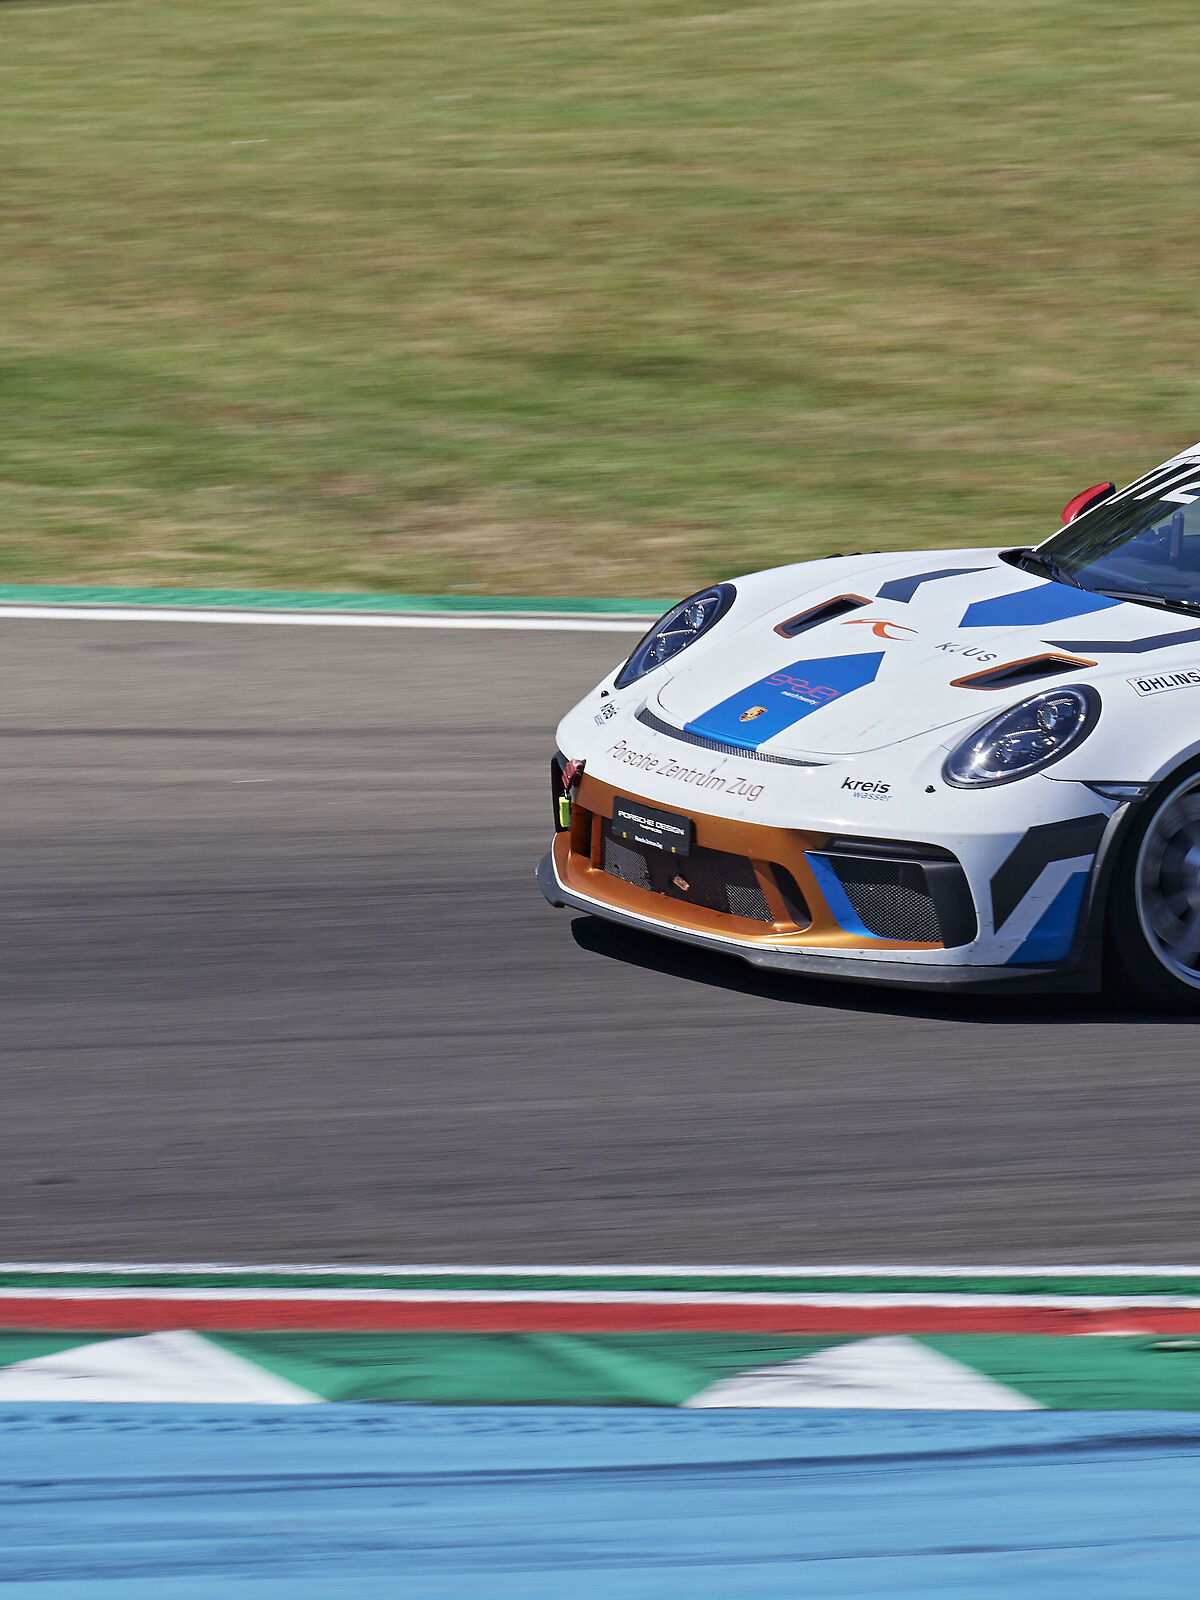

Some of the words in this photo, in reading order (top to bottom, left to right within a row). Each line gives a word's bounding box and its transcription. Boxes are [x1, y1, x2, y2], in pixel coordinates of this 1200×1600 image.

[605, 739, 659, 772] Porsche
[655, 758, 726, 791] Zentrum
[725, 777, 766, 802] Zug
[841, 776, 891, 794] kreis
[853, 791, 893, 802] wasser
[618, 810, 655, 827] PORSCHE
[655, 821, 685, 836] DESIGN
